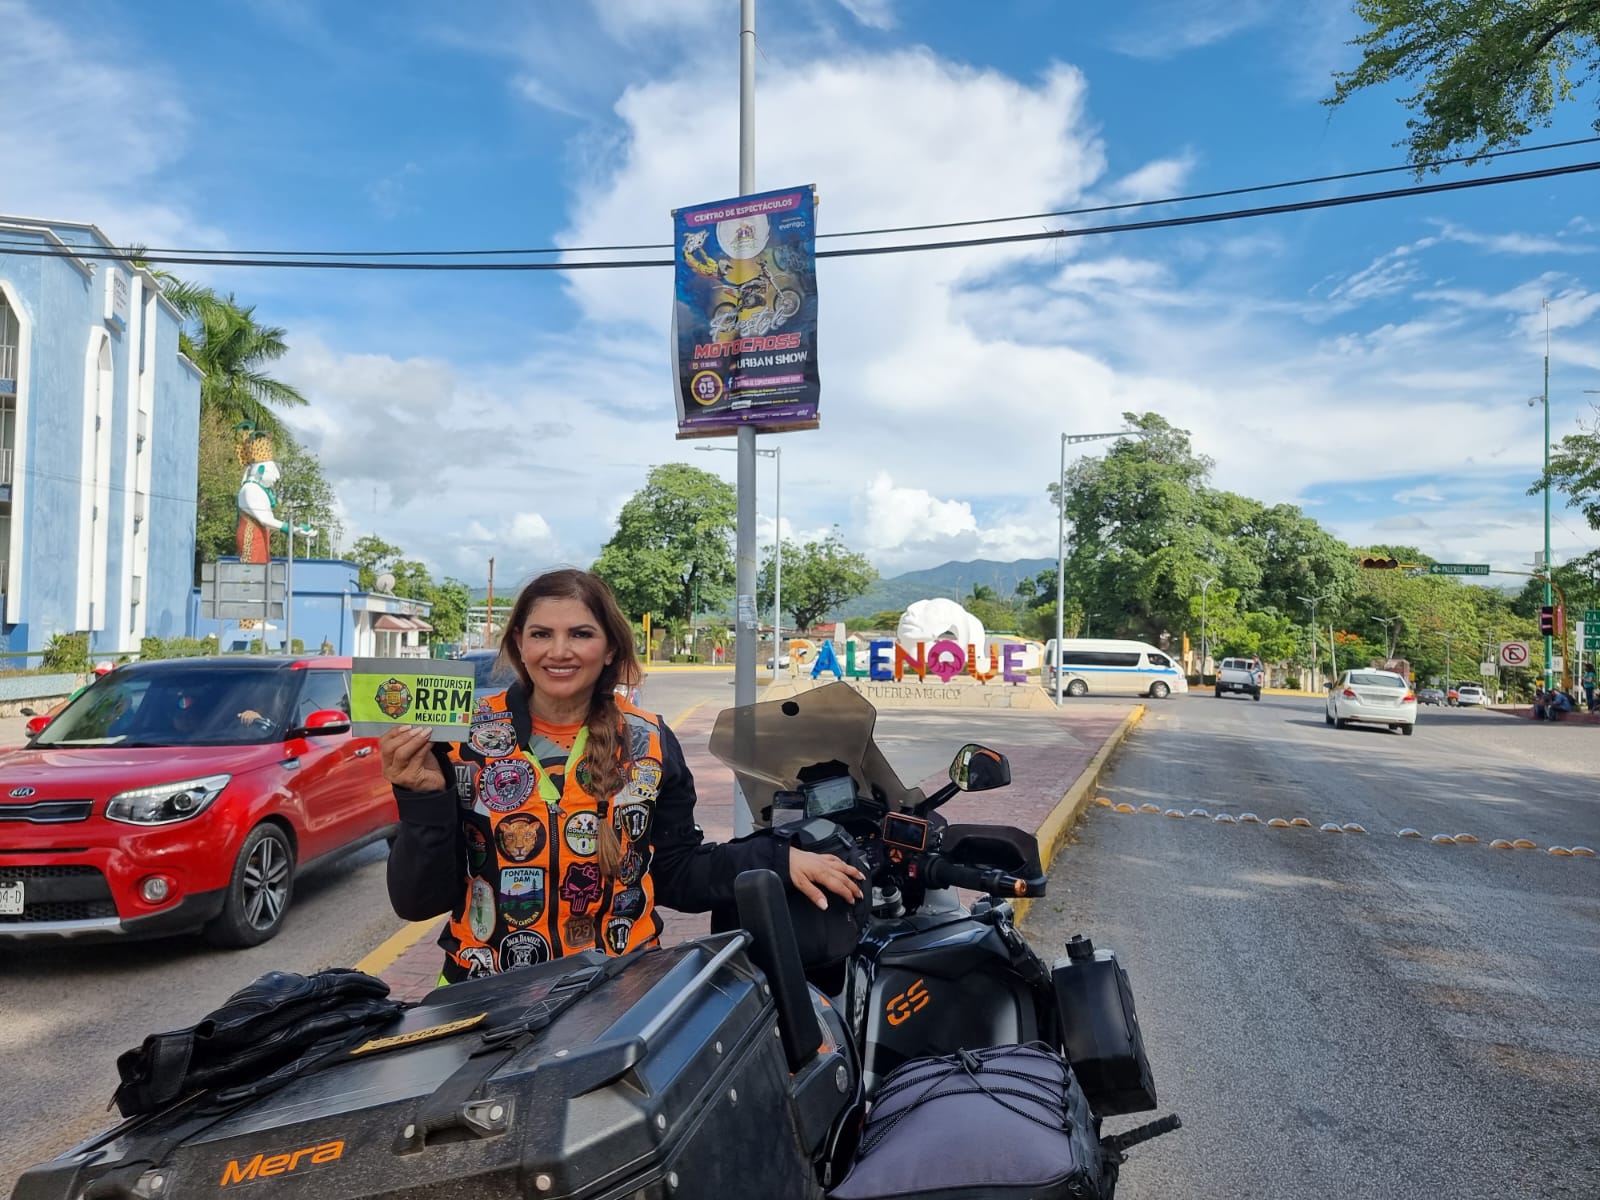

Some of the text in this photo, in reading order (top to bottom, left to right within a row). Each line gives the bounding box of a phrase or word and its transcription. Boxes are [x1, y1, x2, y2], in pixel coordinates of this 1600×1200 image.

[694, 198, 793, 223] CENTRO DE ESPECTÁCULOS
[694, 332, 802, 359] MOTOCROSS
[737, 351, 808, 369] URBAN SHOW
[699, 380, 715, 394] 05
[788, 638, 1028, 684] PALENQUE
[416, 678, 472, 689] MOTOTURISTA
[867, 686, 911, 698] PUEBLO
[415, 688, 471, 712] RRM
[11, 787, 31, 796] KIA
[504, 869, 540, 877] FONTANA
[503, 911, 540, 926] NORTH CAROLINA
[886, 978, 929, 1026] GS
[220, 1140, 345, 1187] Mera
